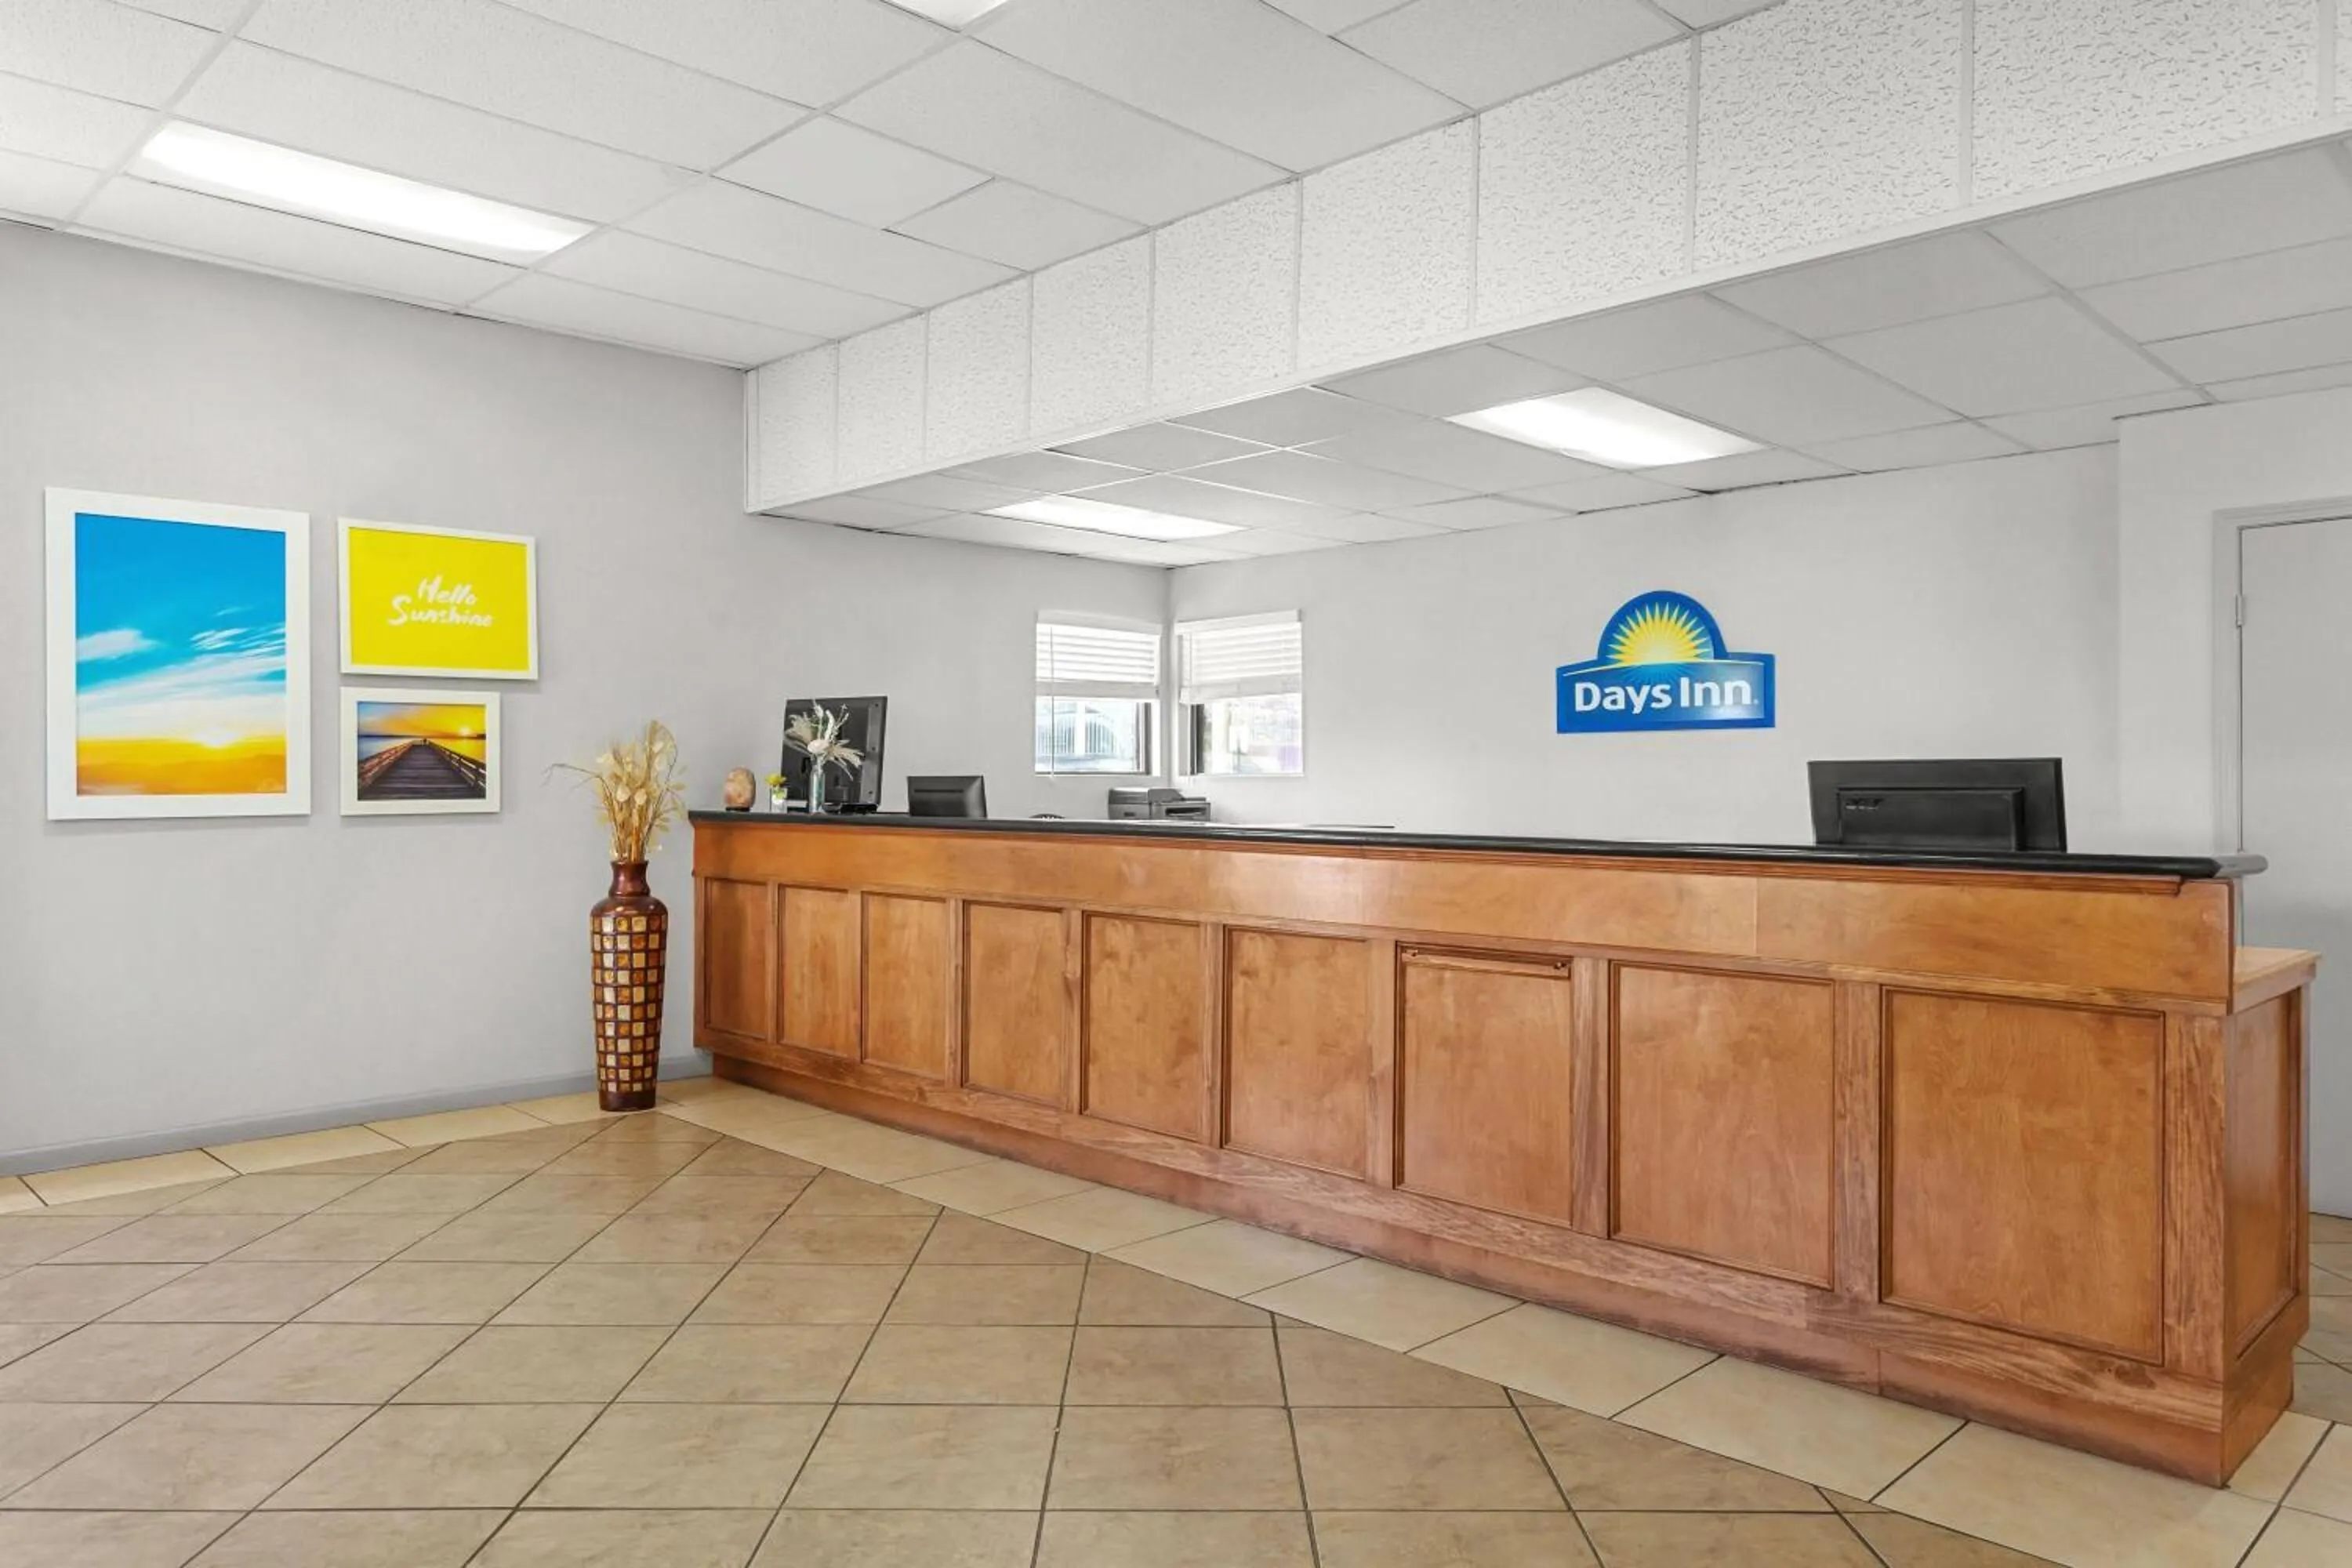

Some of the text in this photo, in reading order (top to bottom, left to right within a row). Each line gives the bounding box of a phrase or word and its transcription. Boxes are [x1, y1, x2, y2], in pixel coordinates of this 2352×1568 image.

[418, 574, 477, 605] Hello
[387, 594, 492, 626] Sunshine
[1575, 677, 1751, 714] Days Inn
